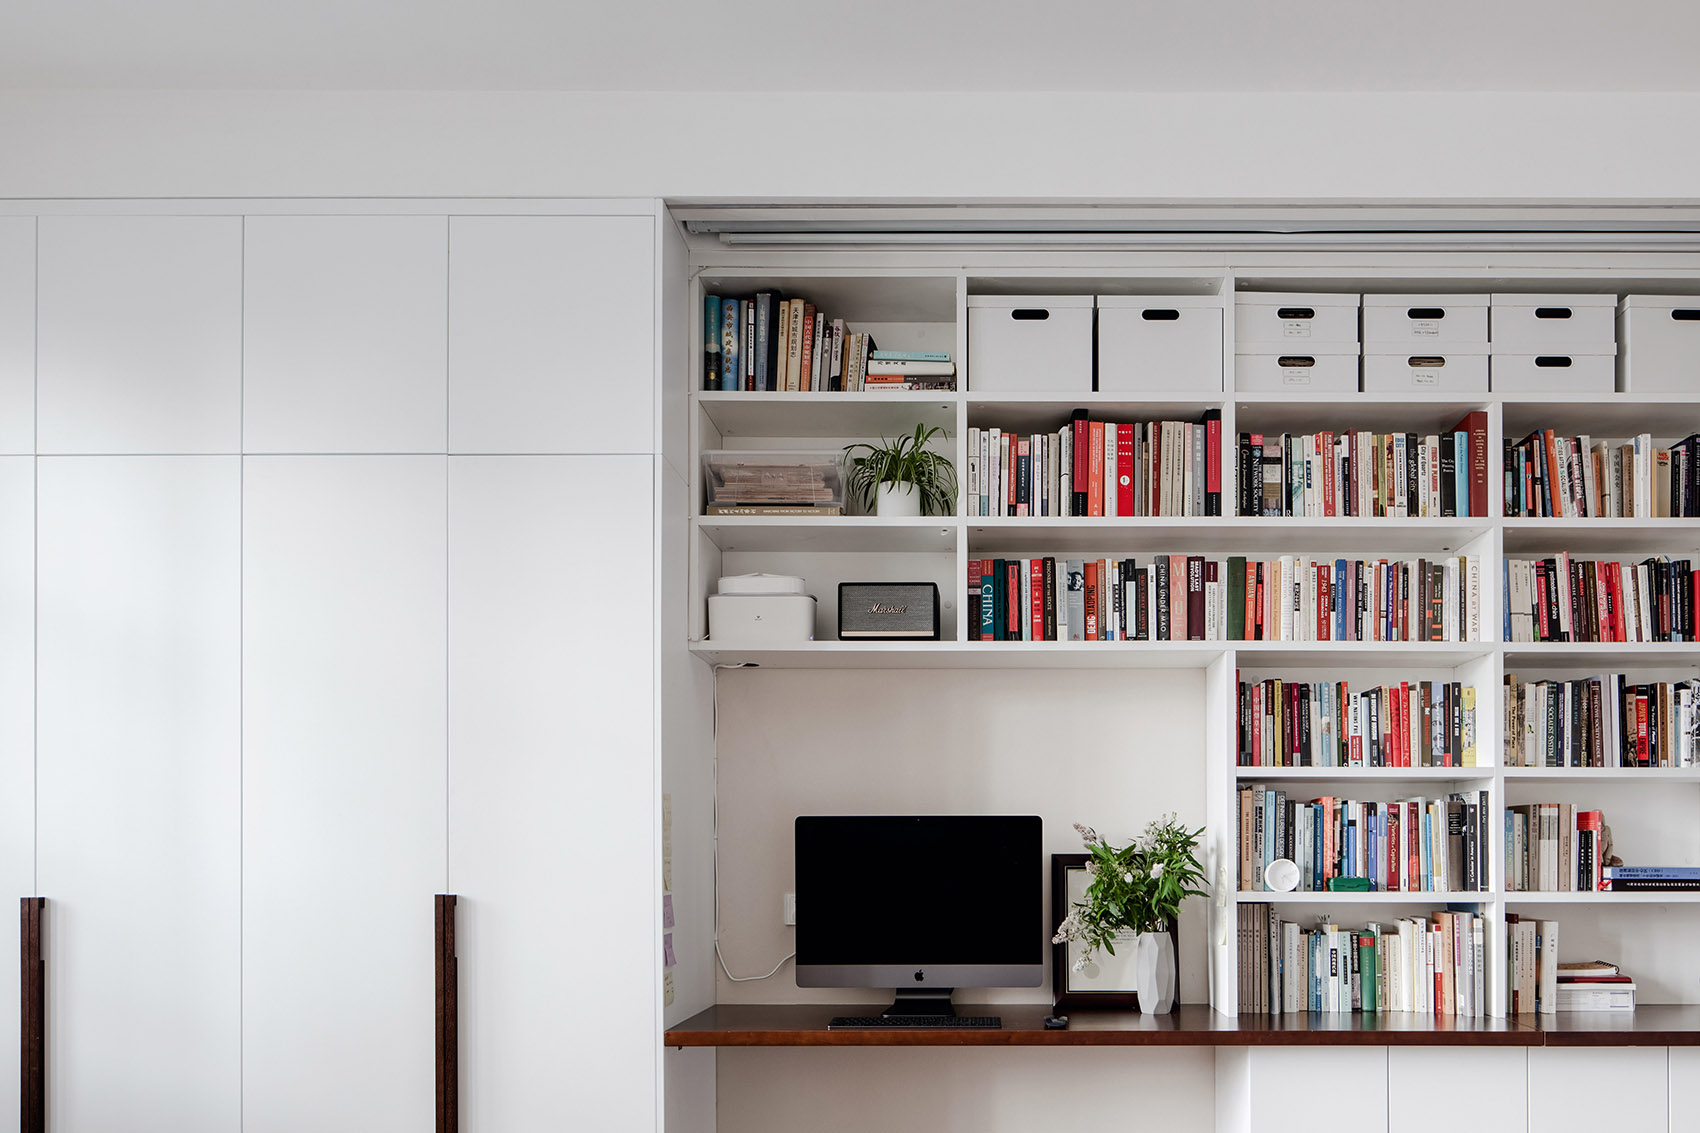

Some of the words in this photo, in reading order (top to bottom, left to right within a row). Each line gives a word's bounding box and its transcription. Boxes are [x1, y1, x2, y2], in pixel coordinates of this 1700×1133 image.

[1556, 440, 1564, 456] CITIES
[1408, 459, 1417, 479] global
[1557, 456, 1565, 469] AFTER
[1252, 458, 1260, 488] NETWORK
[1560, 470, 1568, 496] SOCIALISM
[1575, 479, 1583, 500] UTOPIA
[867, 603, 909, 614] Marshall
[982, 584, 993, 626] CHINA
[1086, 585, 1096, 616] XIAOPING
[1086, 616, 1096, 634] DENG
[1547, 706, 1555, 735] SOCIALIST
[1638, 702, 1646, 722] JAPAN'S
[1638, 722, 1646, 737] TOTAL
[1638, 738, 1647, 755] EMPIRE
